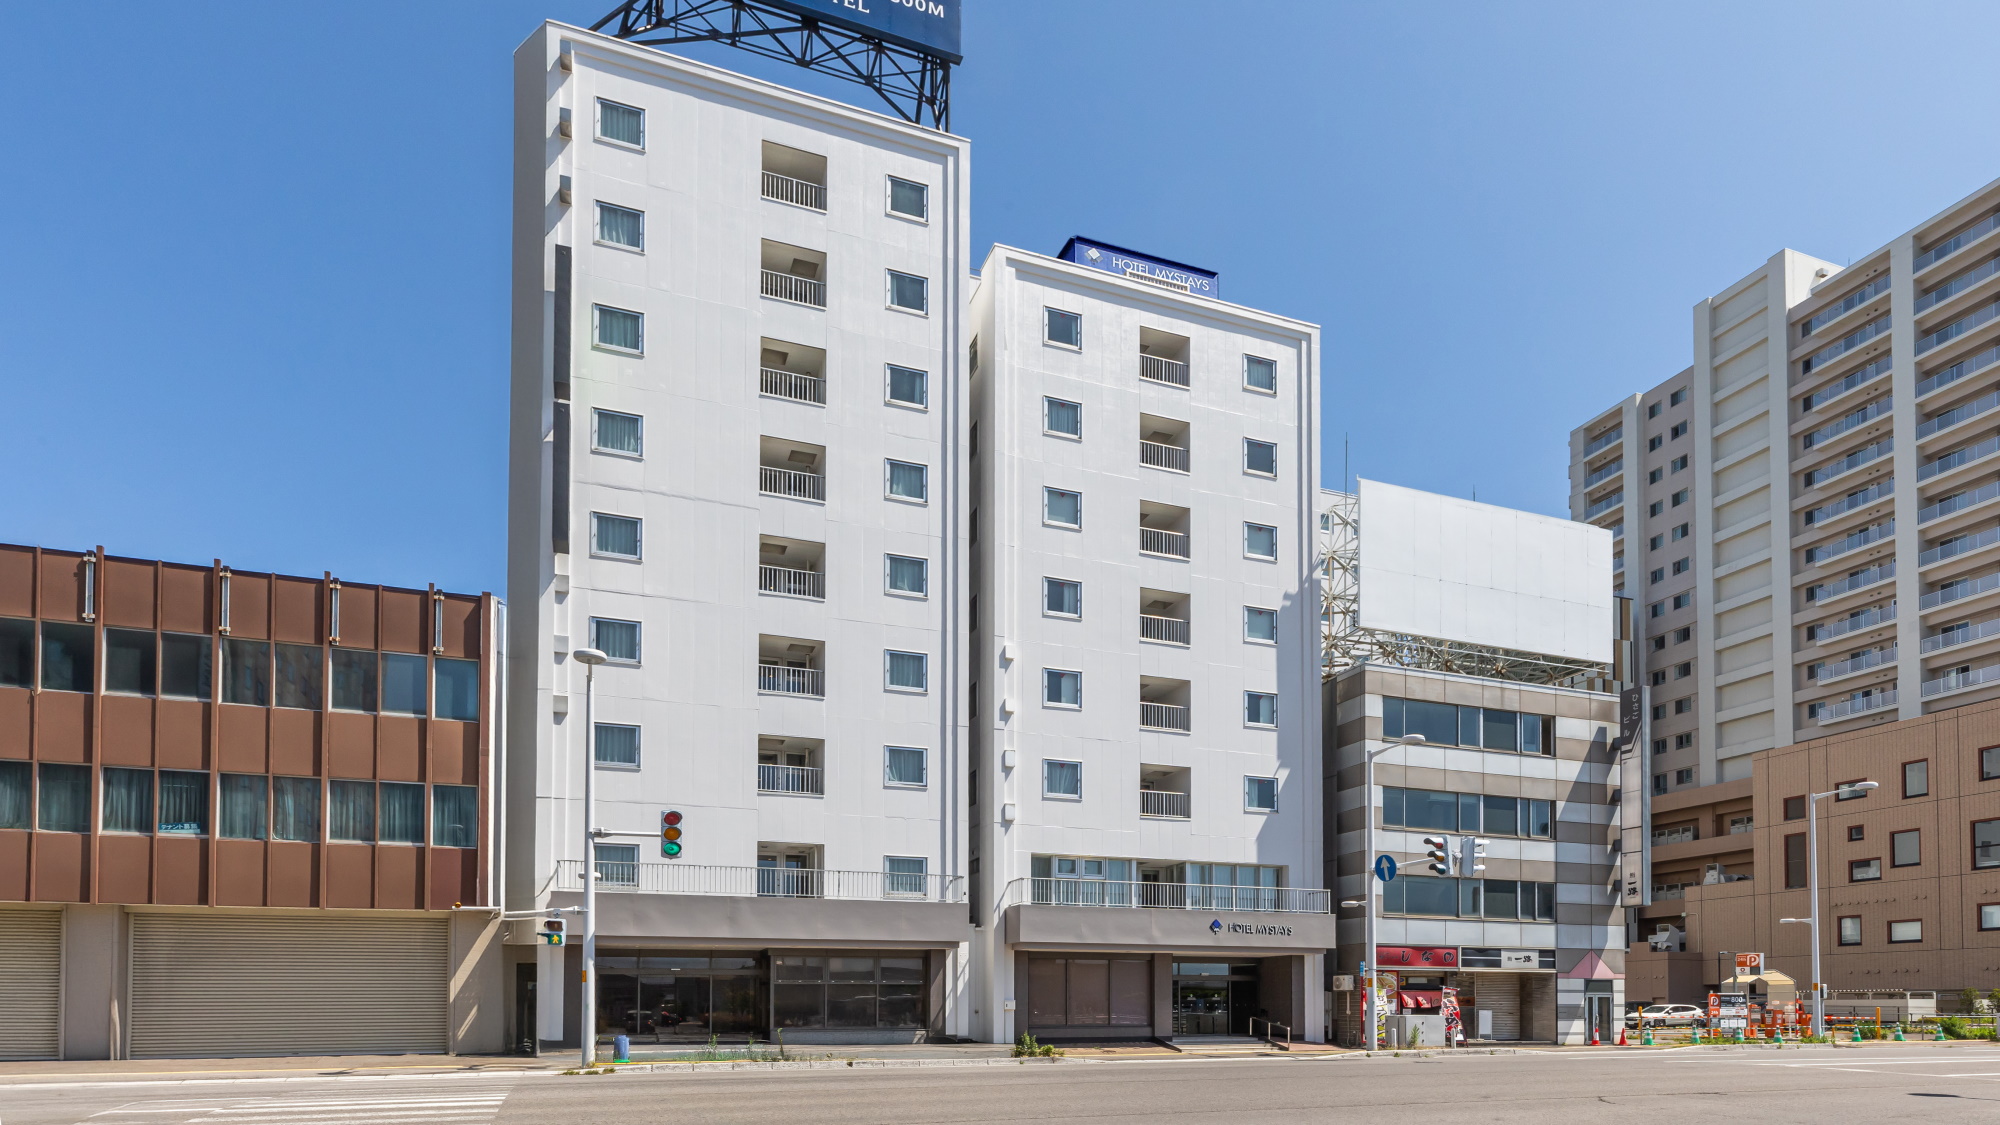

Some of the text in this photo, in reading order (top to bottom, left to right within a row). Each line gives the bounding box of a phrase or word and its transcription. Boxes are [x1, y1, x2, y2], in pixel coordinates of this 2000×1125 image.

[1112, 256, 1210, 291] HOTEL MYSTAYS
[1227, 922, 1292, 937] HOTEL MYSTAYS
[1401, 950, 1455, 963] しなの
